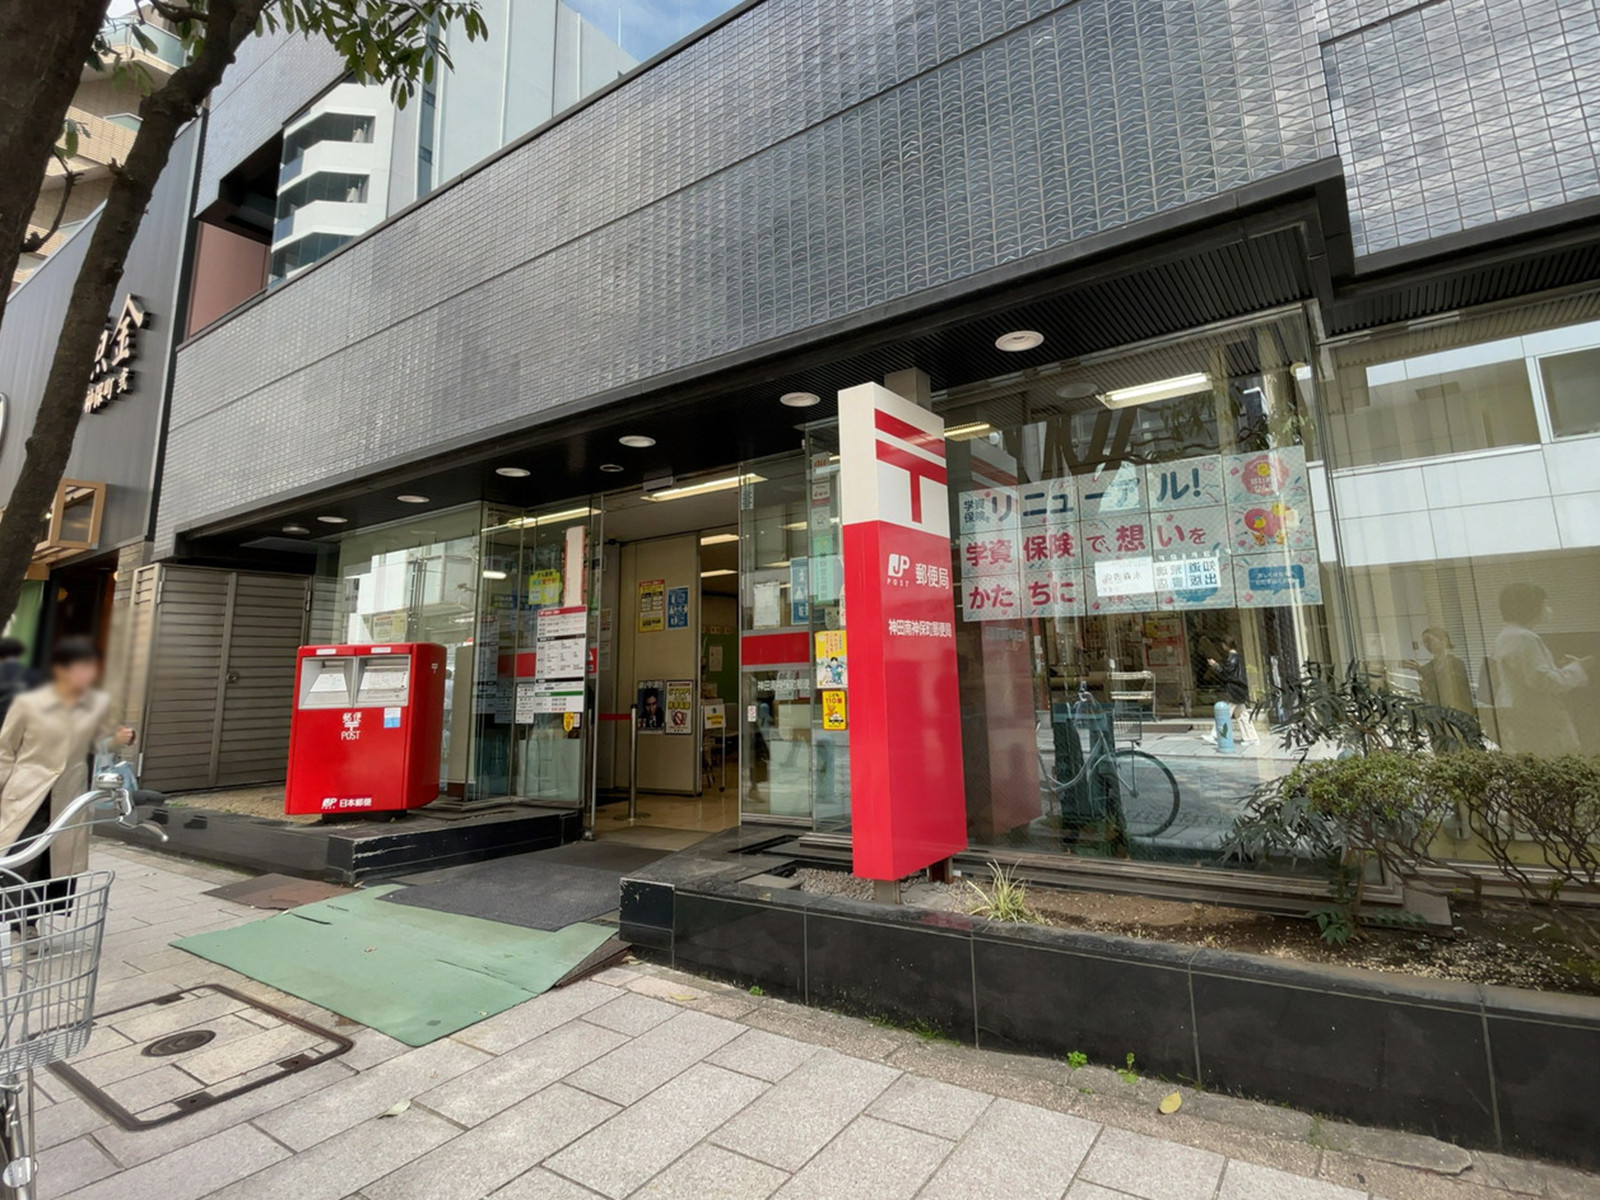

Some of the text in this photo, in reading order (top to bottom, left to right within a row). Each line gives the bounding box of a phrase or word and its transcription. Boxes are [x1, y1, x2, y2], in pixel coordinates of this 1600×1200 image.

[965, 524, 1207, 567] 学資保険で、想いを
[915, 562, 950, 590] 郵便局
[886, 578, 911, 588] POST
[969, 580, 1076, 609] かたちに
[342, 711, 362, 724] 郵便
[340, 730, 362, 741] POST
[339, 797, 372, 808] 日本郵便
